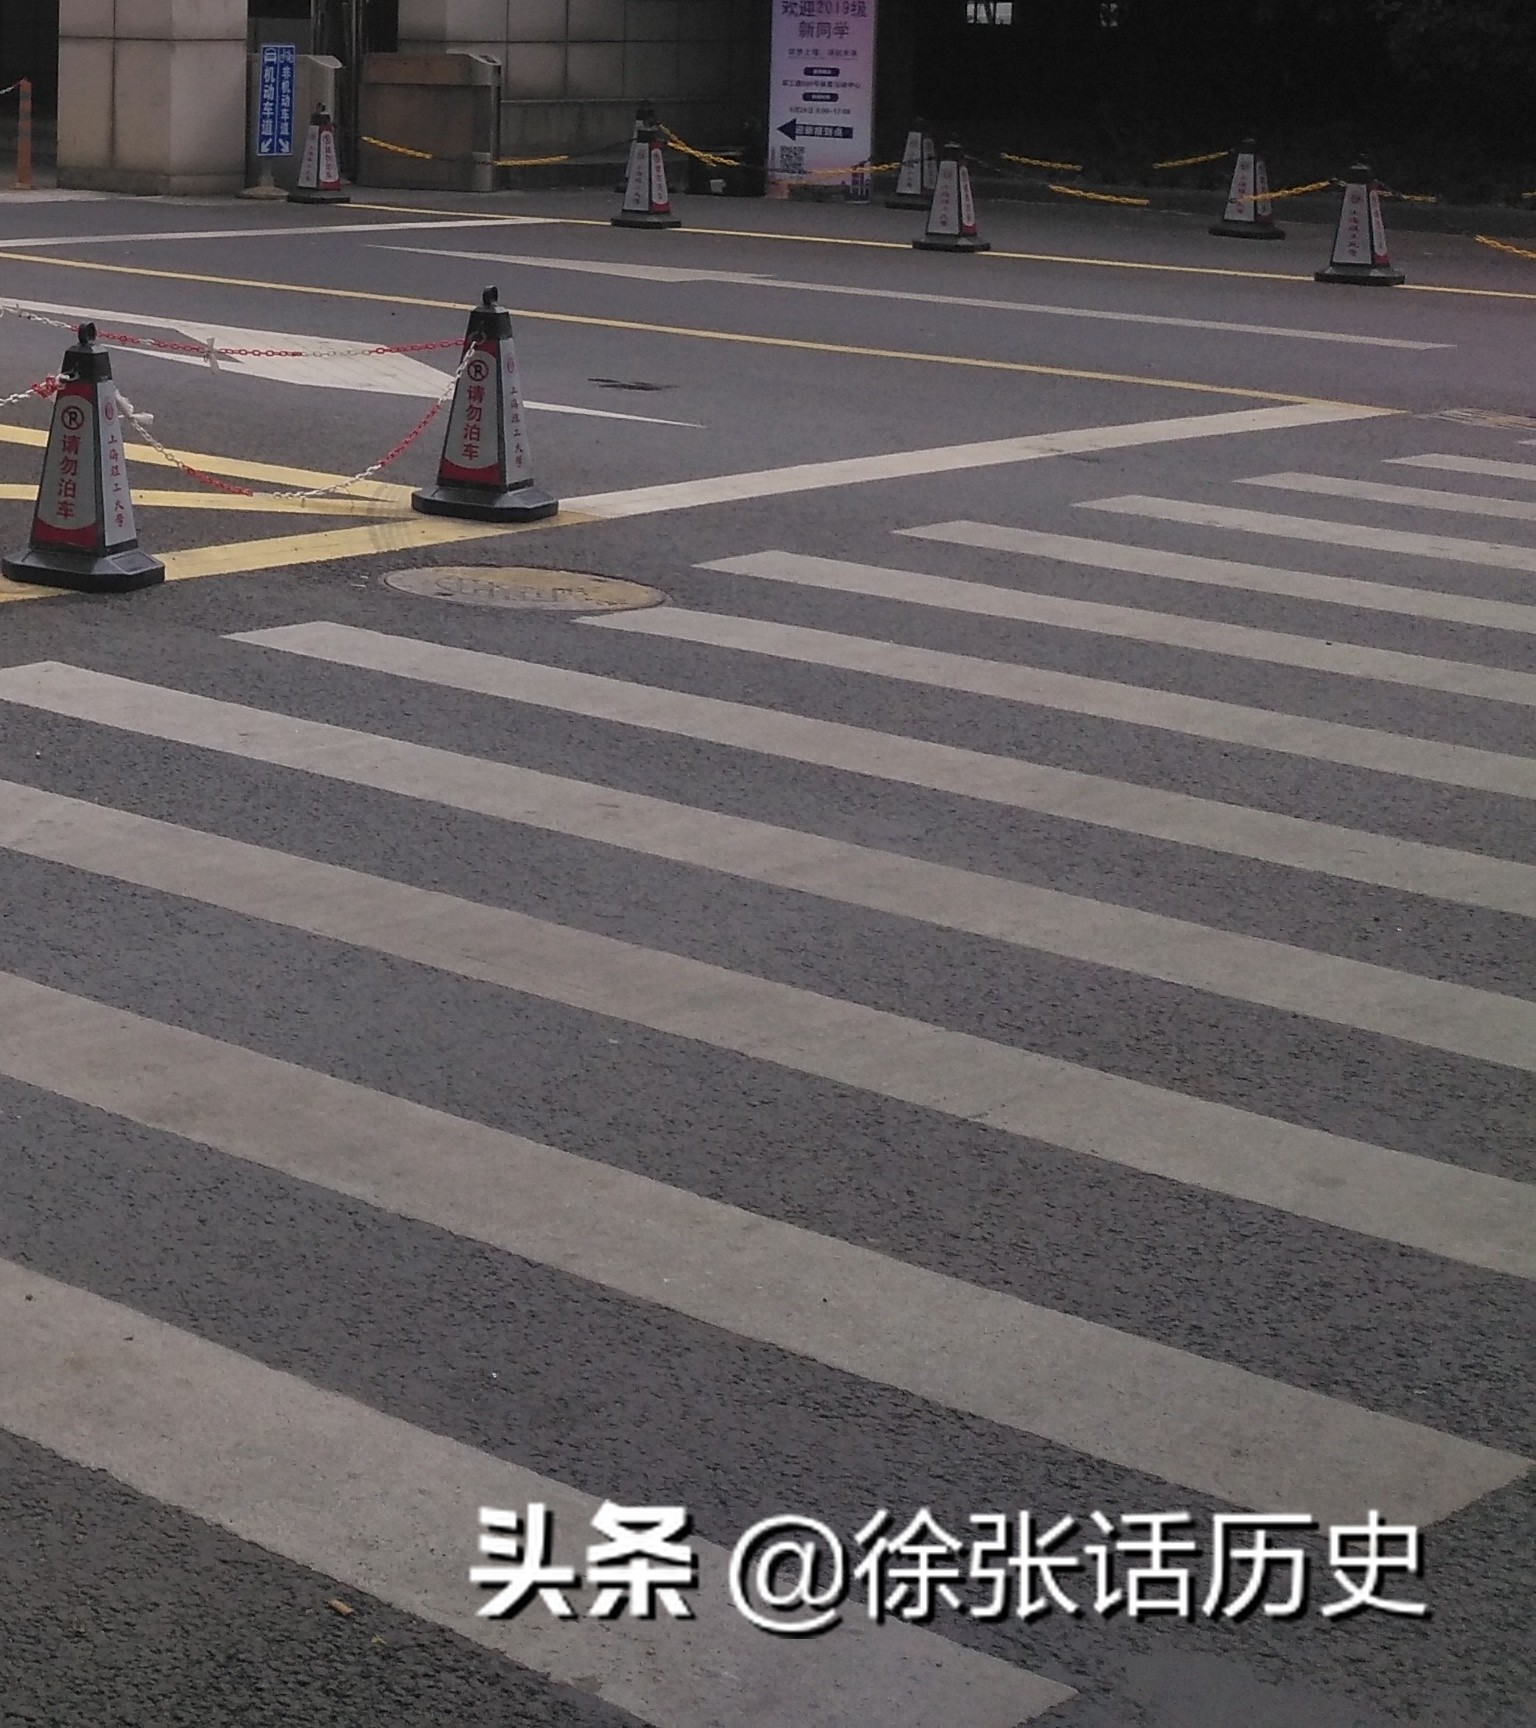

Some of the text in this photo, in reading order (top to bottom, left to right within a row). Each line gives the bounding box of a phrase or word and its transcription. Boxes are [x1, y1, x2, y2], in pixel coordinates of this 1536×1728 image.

[782, 0, 867, 18] 欢迎2019级
[798, 20, 850, 39] 新同学
[261, 66, 275, 136] 机动车道
[462, 385, 486, 461] 请勿泊车
[56, 434, 82, 519] 请勿泊车
